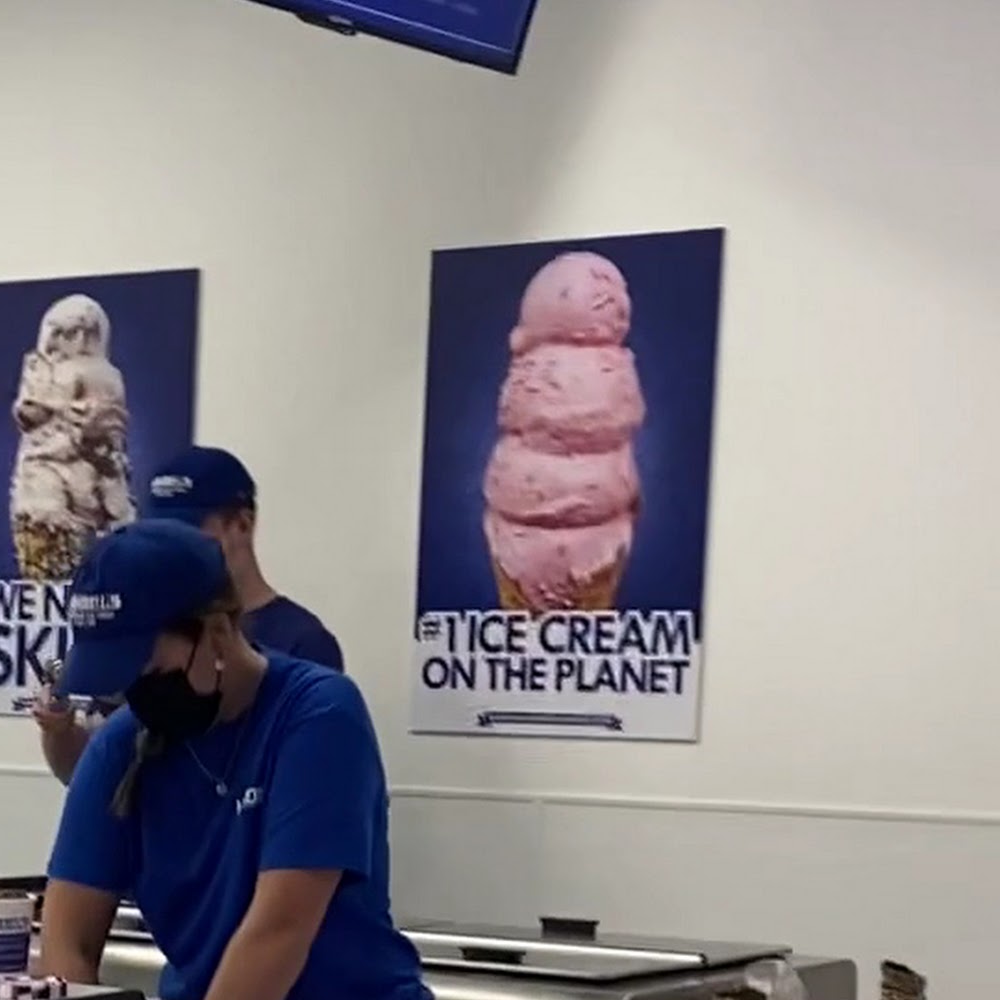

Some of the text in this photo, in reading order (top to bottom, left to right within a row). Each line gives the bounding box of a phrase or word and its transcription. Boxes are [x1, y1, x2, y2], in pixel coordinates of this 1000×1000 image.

[466, 613, 528, 654] ICE
[540, 614, 690, 656] CREAM
[422, 656, 690, 694] ON THE PLANET
